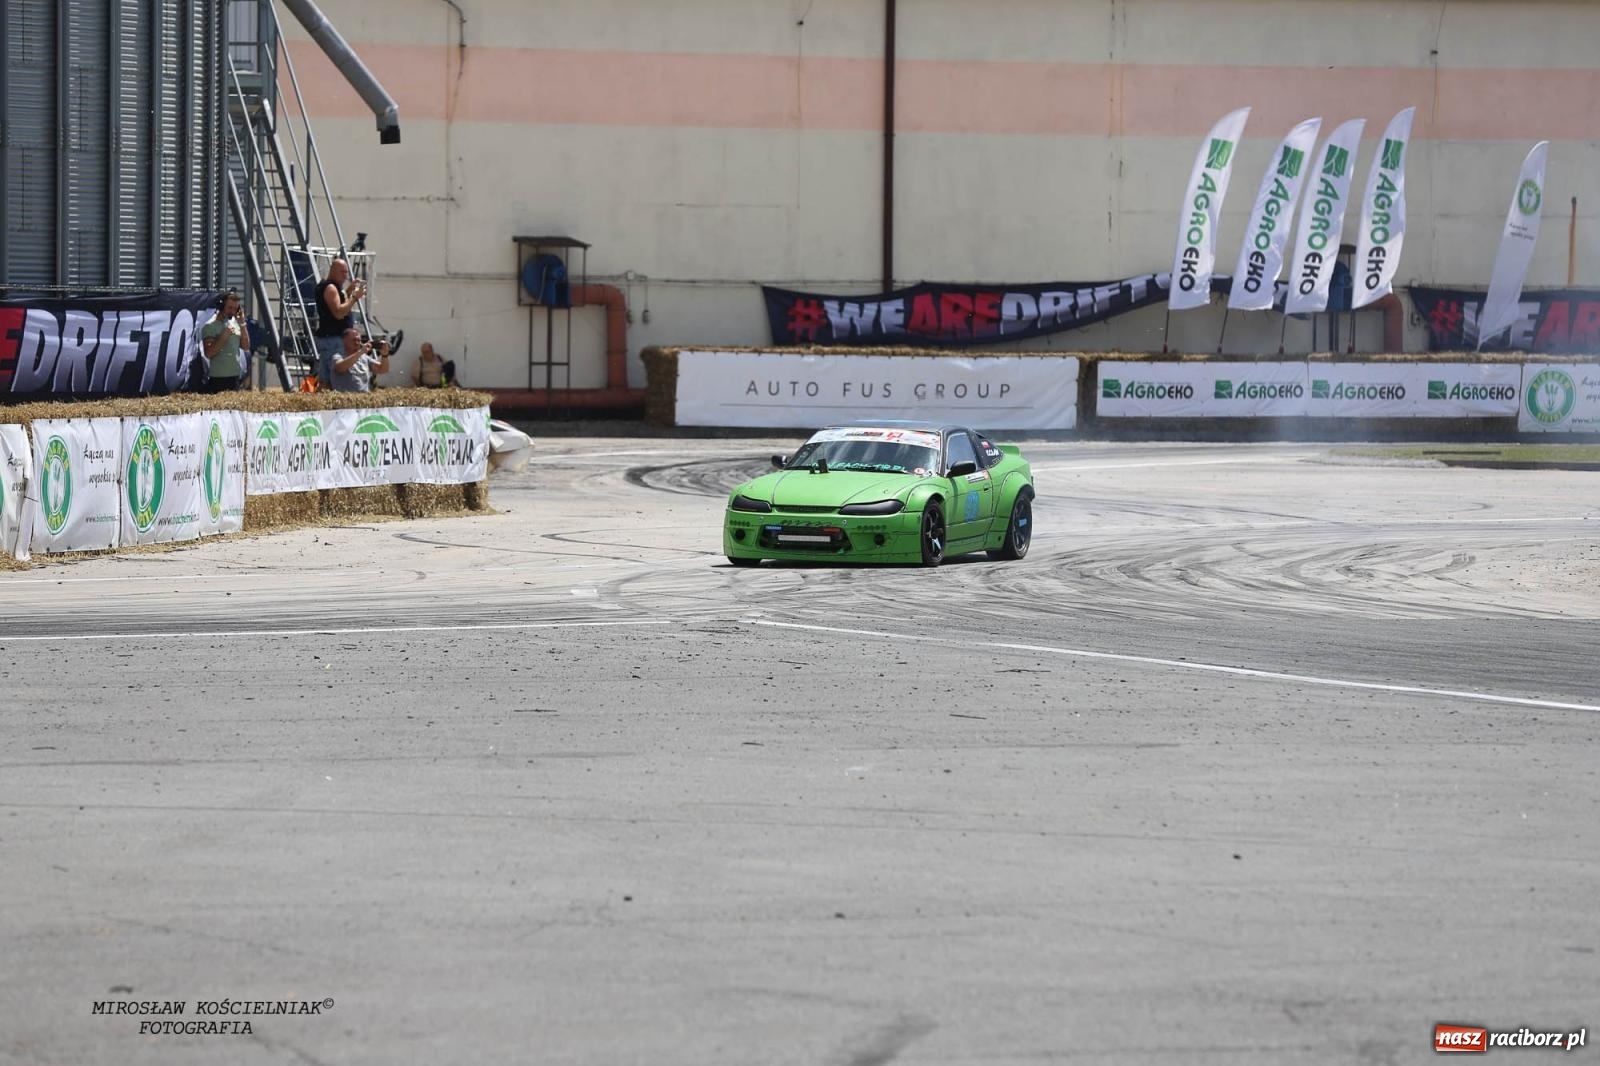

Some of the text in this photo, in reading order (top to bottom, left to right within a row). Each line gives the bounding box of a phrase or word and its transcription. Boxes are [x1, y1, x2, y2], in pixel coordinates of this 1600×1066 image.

[1179, 173, 1217, 292] AGROEKO
[1244, 178, 1290, 293] AGROEKO
[1300, 178, 1340, 296] AGROEKO
[1365, 173, 1399, 290] AGROEKO
[746, 380, 1011, 400] AUTO FUS GROUP
[1123, 381, 1194, 399] AGROEKO
[1235, 381, 1304, 399] AGROEKO
[1332, 382, 1406, 400] AGROEKO
[1449, 382, 1515, 400] AGROEKO
